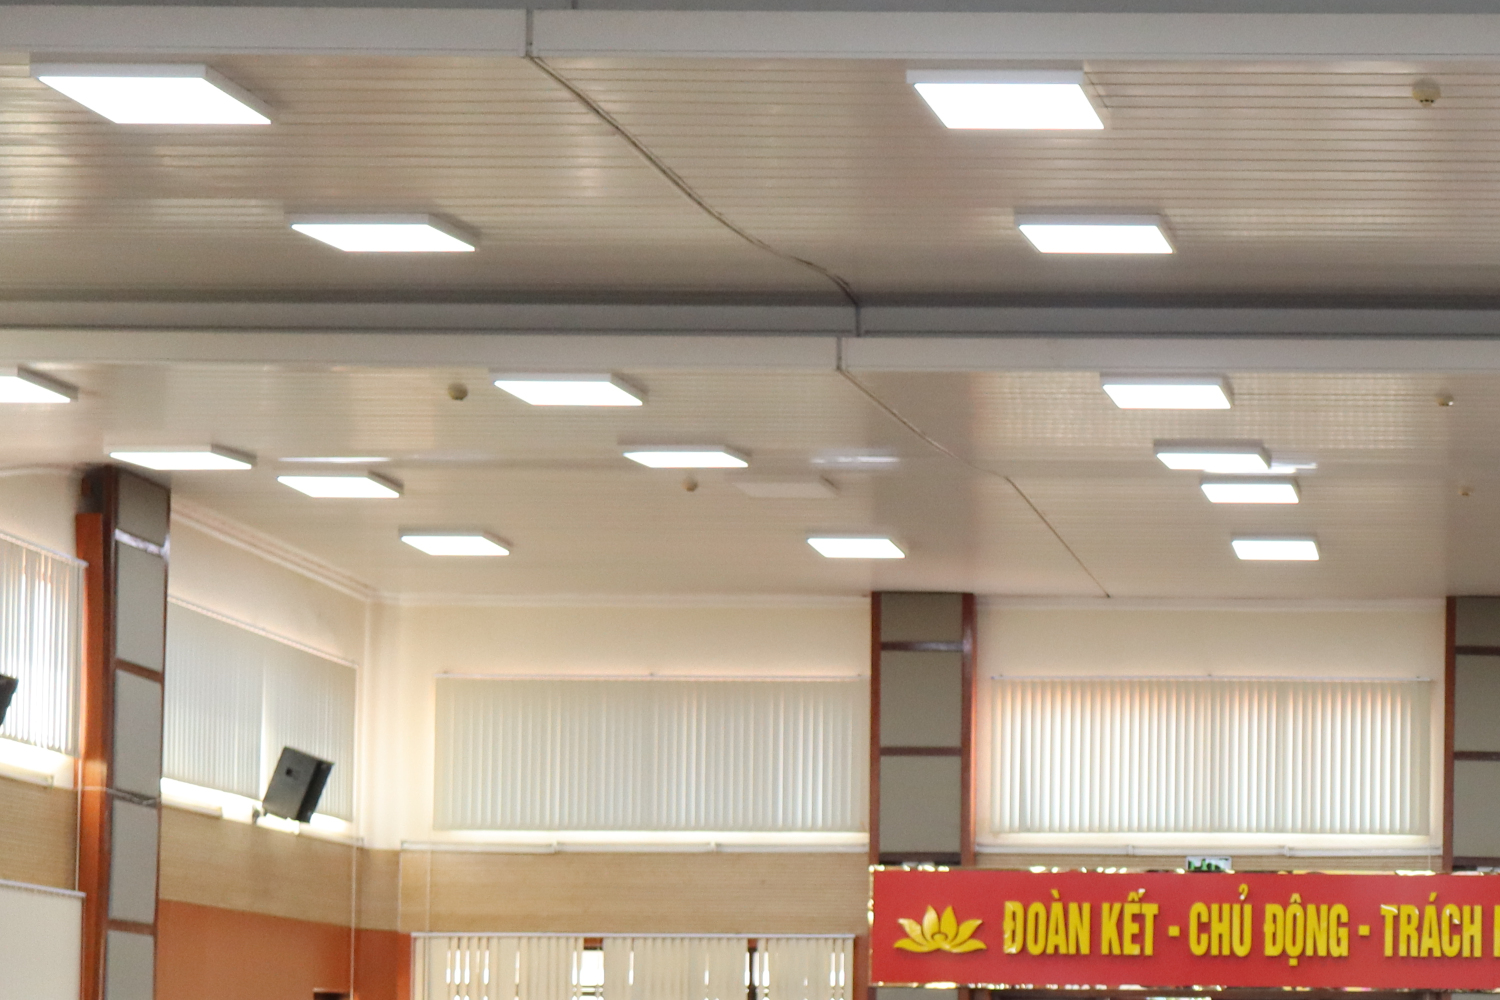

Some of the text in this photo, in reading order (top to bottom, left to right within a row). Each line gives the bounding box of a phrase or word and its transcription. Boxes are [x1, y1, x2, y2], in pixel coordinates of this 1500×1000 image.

[1002, 888, 1091, 956] ĐOÀN
[1101, 887, 1159, 956] KẾT
[1188, 883, 1253, 958] CHỦ
[1263, 893, 1349, 967] ĐỘNG
[1379, 892, 1483, 958] TRÁCH
